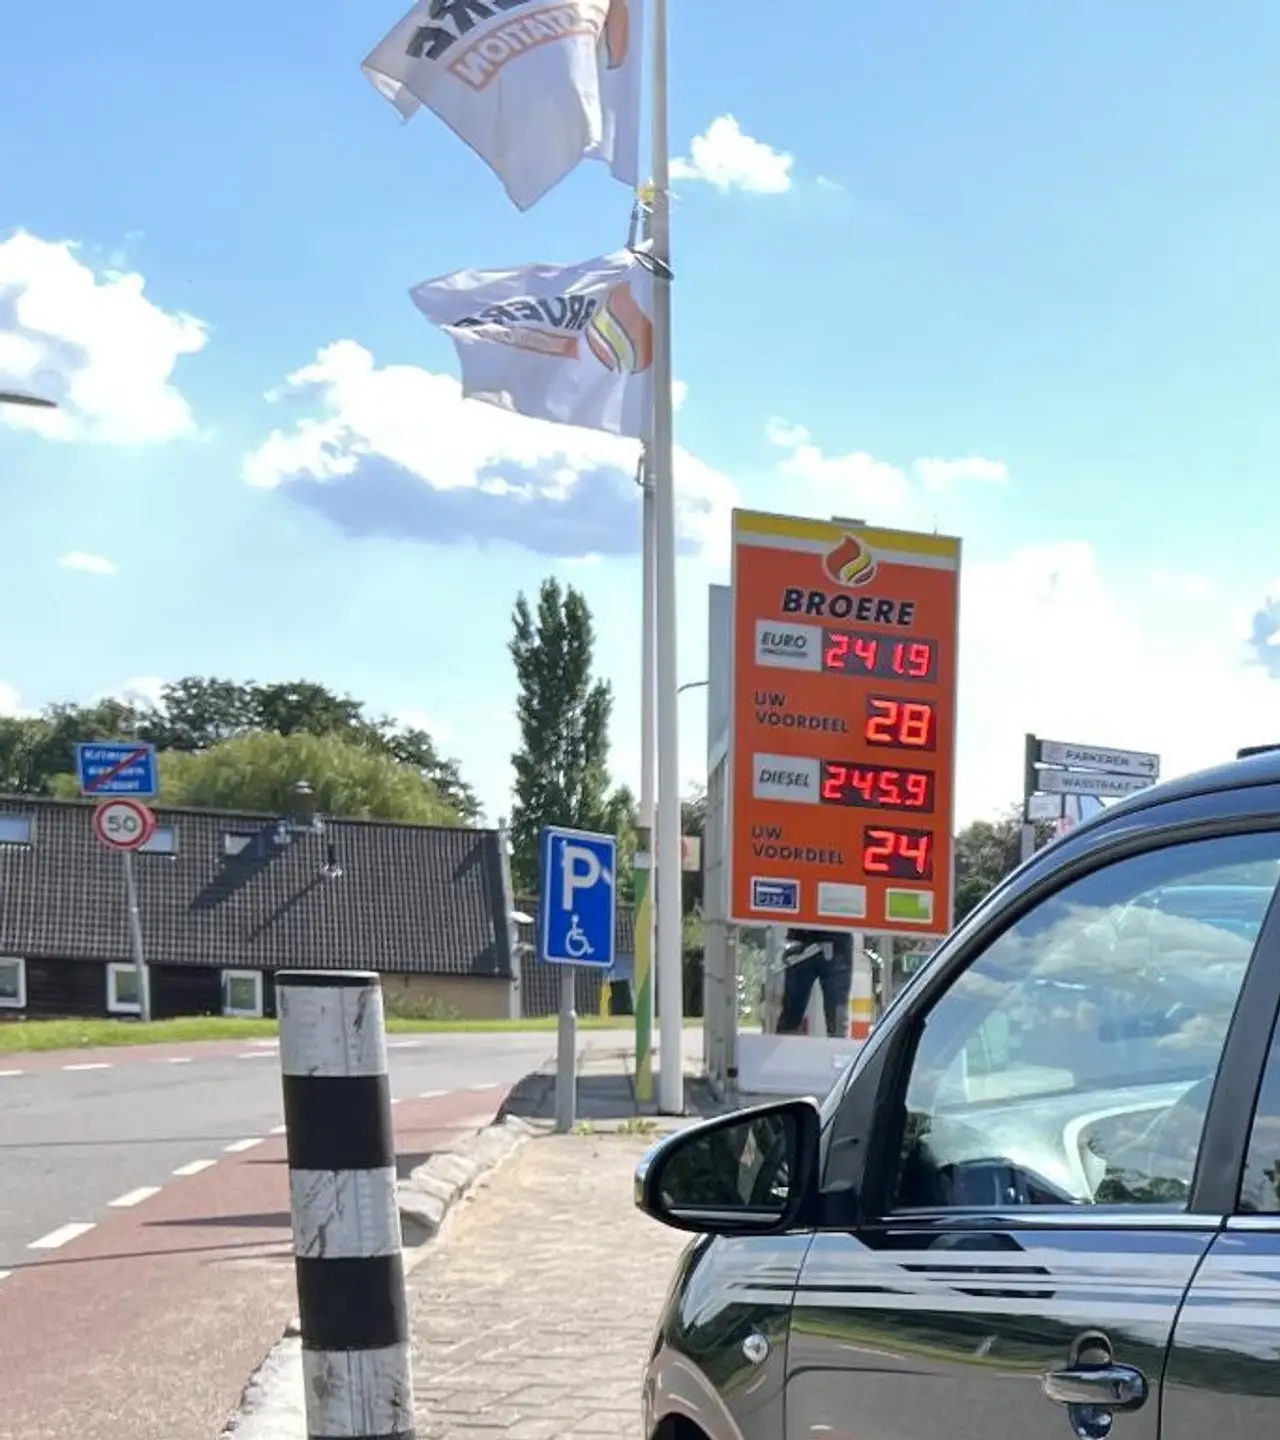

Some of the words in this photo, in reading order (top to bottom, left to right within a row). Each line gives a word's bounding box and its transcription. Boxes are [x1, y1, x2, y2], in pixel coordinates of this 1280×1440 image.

[782, 588, 915, 625] BROERE
[761, 631, 807, 649] EURO
[755, 691, 785, 706] UW
[756, 711, 848, 733] VOORDEEL
[866, 699, 931, 745] 28
[759, 769, 810, 787] DIESEL
[108, 815, 137, 833] 50
[752, 825, 782, 840] UW
[752, 844, 844, 865] VOORDEEL
[864, 830, 928, 874] 24
[562, 841, 601, 911] P
